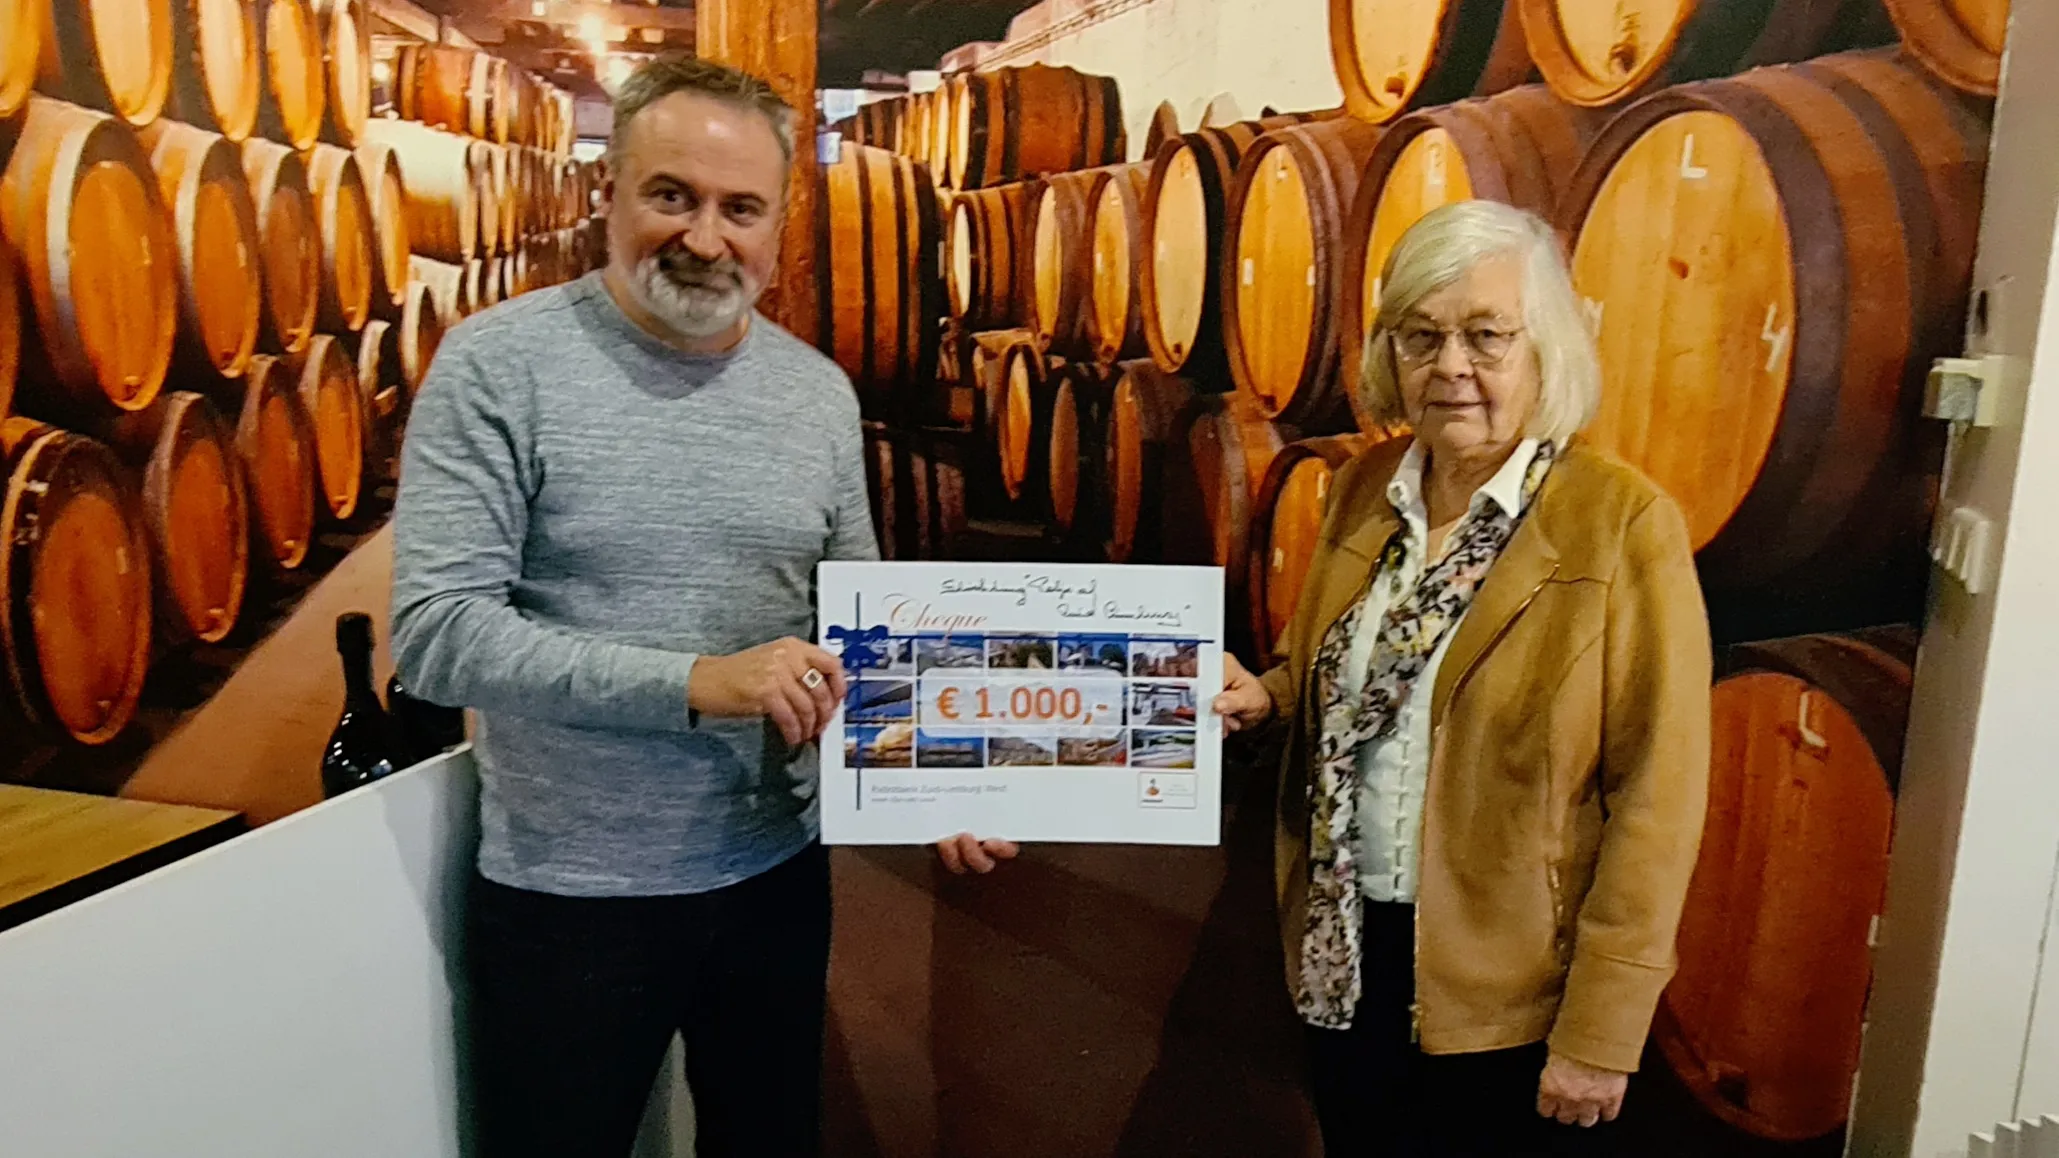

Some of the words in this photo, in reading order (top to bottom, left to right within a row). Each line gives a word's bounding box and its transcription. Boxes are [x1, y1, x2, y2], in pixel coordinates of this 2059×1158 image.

[1680, 133, 1706, 179] L
[881, 593, 987, 645] Cheque
[937, 686, 960, 720] €
[975, 686, 1108, 725] 1.000,-
